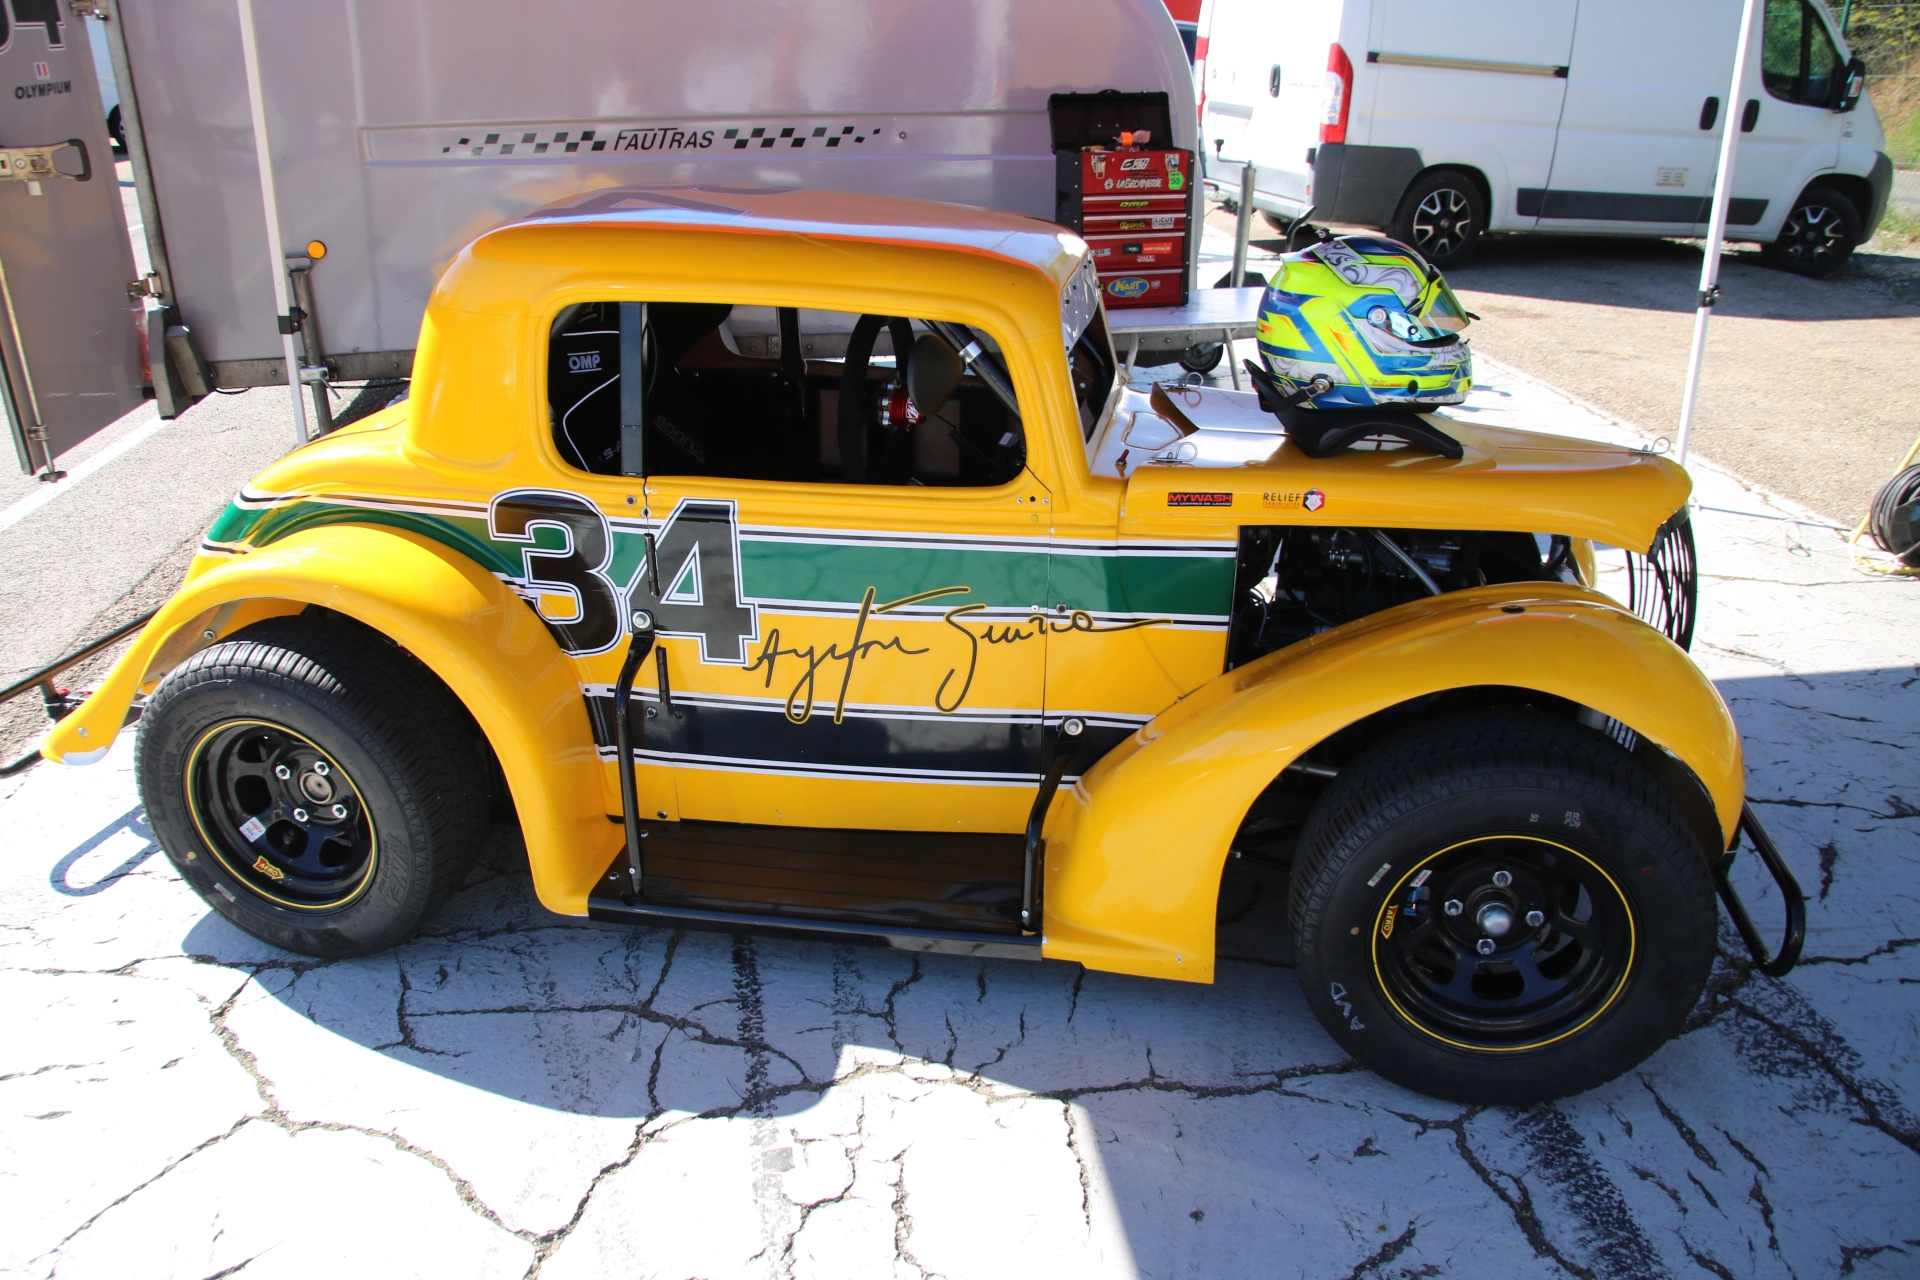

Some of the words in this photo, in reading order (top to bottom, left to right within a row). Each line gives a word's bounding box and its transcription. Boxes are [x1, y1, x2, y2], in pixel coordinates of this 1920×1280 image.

[15, 81, 71, 99] OLYMPIUM
[613, 127, 715, 151] FAUTRAS
[1114, 280, 1144, 292] KART
[569, 354, 601, 371] OMP
[1168, 493, 1232, 502] MYWASH
[1263, 493, 1300, 502] RELIEF
[488, 487, 760, 667] 34
[258, 862, 278, 877] AERO
[1383, 909, 1394, 931] AERO
